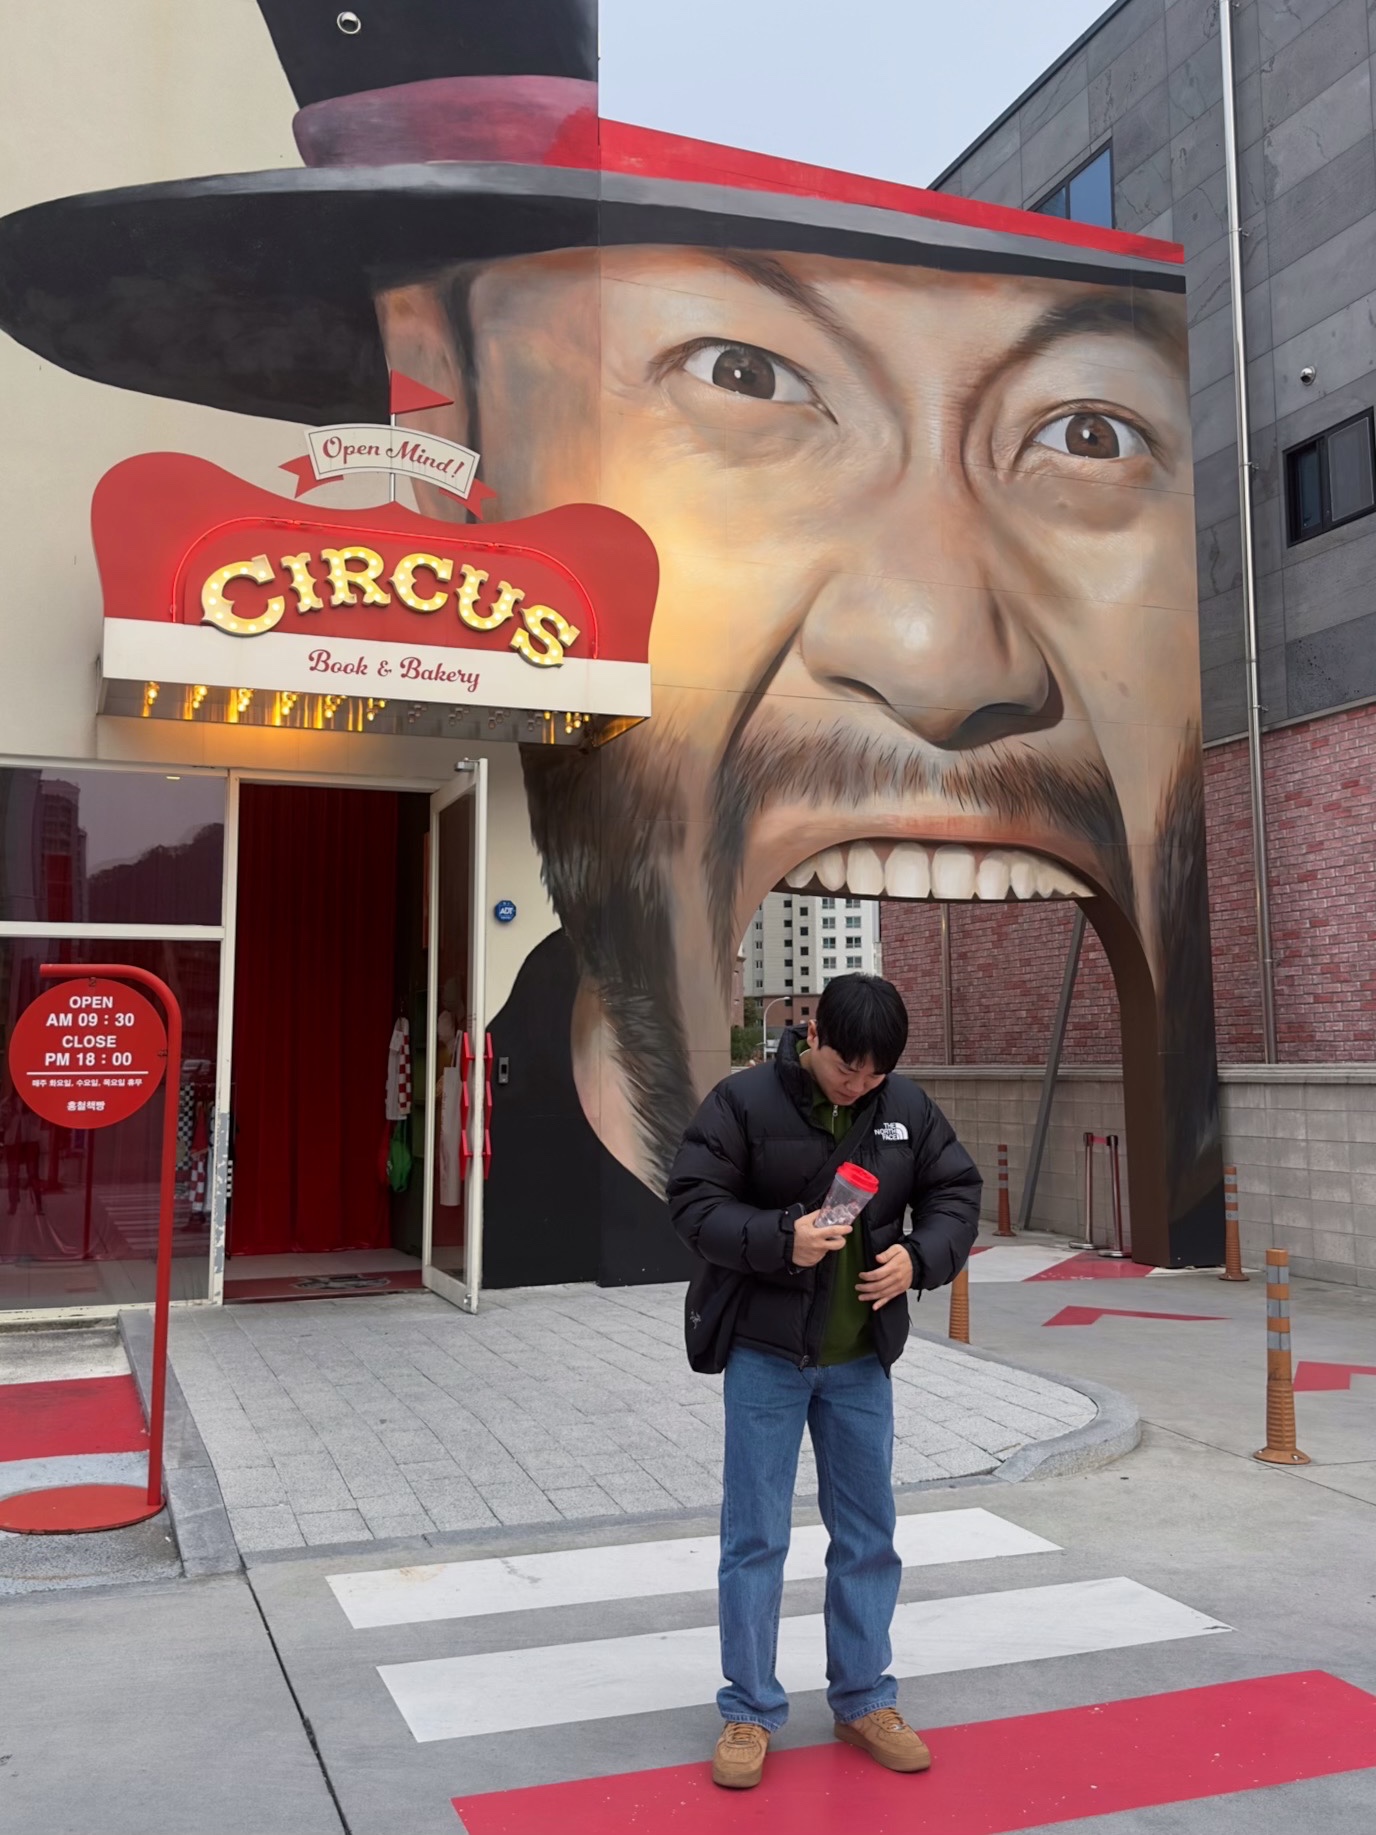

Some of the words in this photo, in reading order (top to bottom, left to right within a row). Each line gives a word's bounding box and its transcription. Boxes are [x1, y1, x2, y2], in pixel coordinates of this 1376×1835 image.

[322, 436, 380, 464] Open
[201, 546, 581, 668] CIRCUS
[308, 649, 368, 676] Book
[377, 659, 392, 677] &
[399, 656, 481, 693] Bakery
[499, 907, 513, 915] ADT
[69, 996, 114, 1009] OPEN
[46, 1013, 73, 1027] AM
[62, 1035, 117, 1048] CLOSE
[45, 1052, 70, 1066] PM
[31, 1079, 47, 1087] 매주
[127, 1078, 143, 1087] 휴무
